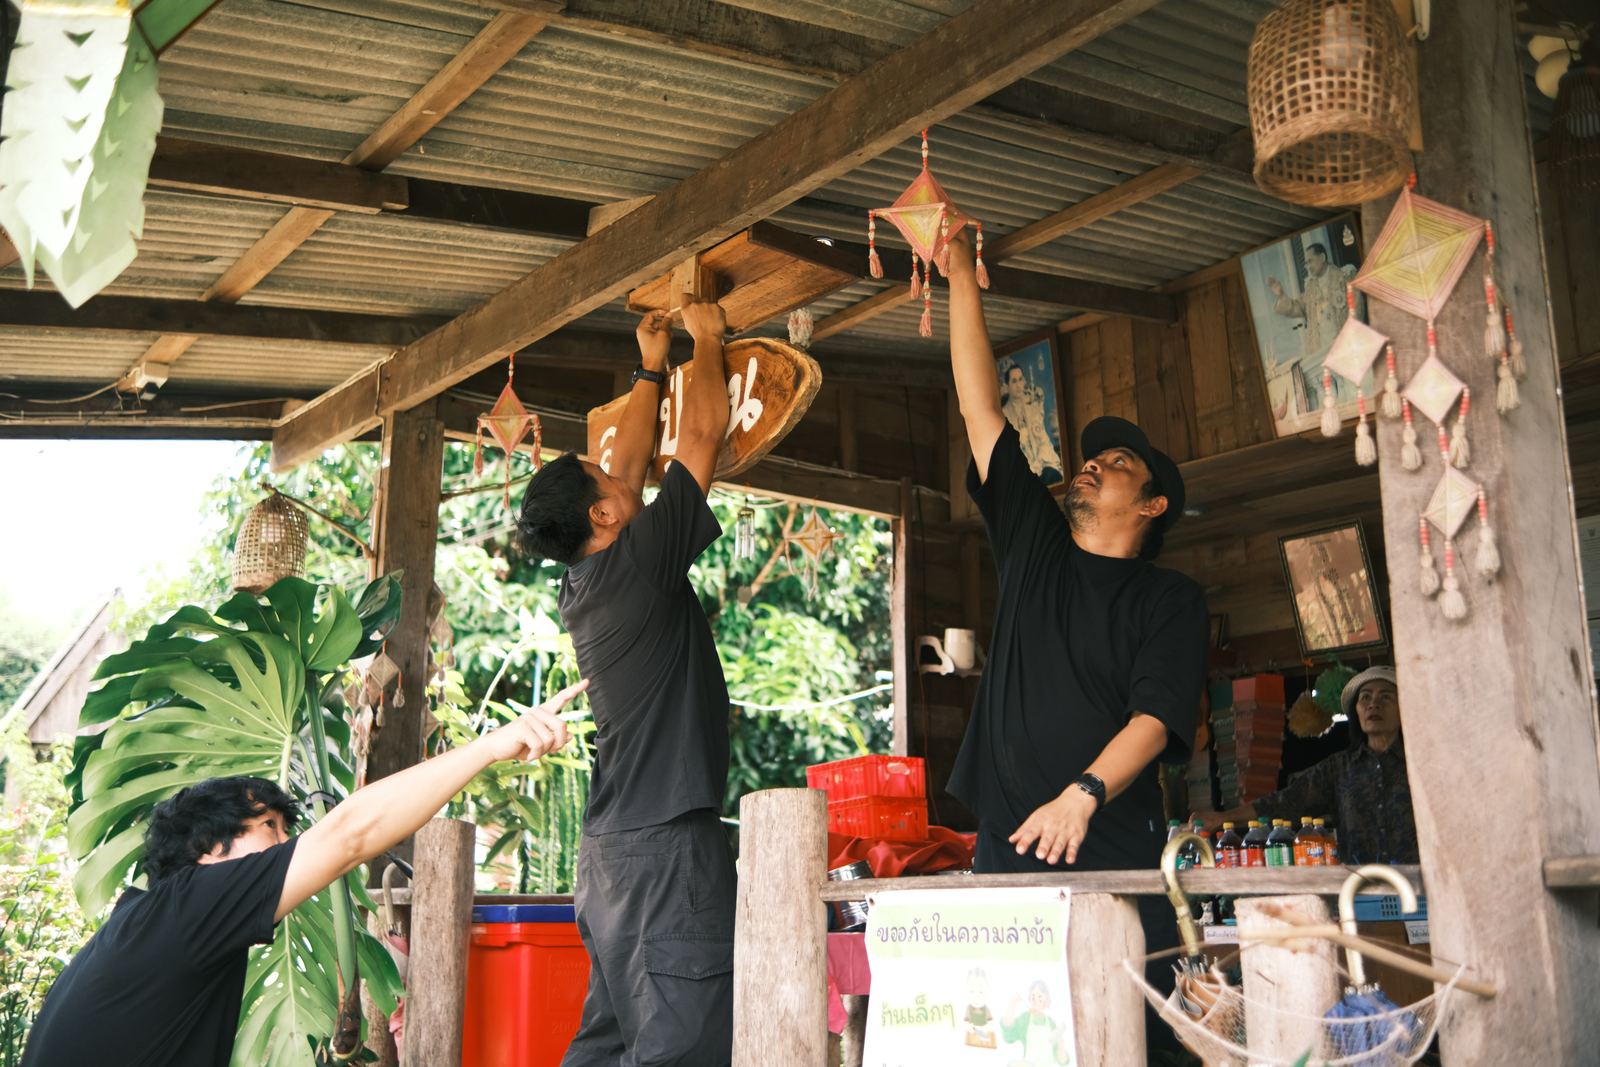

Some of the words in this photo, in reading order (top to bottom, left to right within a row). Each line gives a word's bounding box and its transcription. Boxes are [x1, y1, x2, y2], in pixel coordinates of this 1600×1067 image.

[876, 912, 1054, 945] ขออภัยในความล่าช้า
